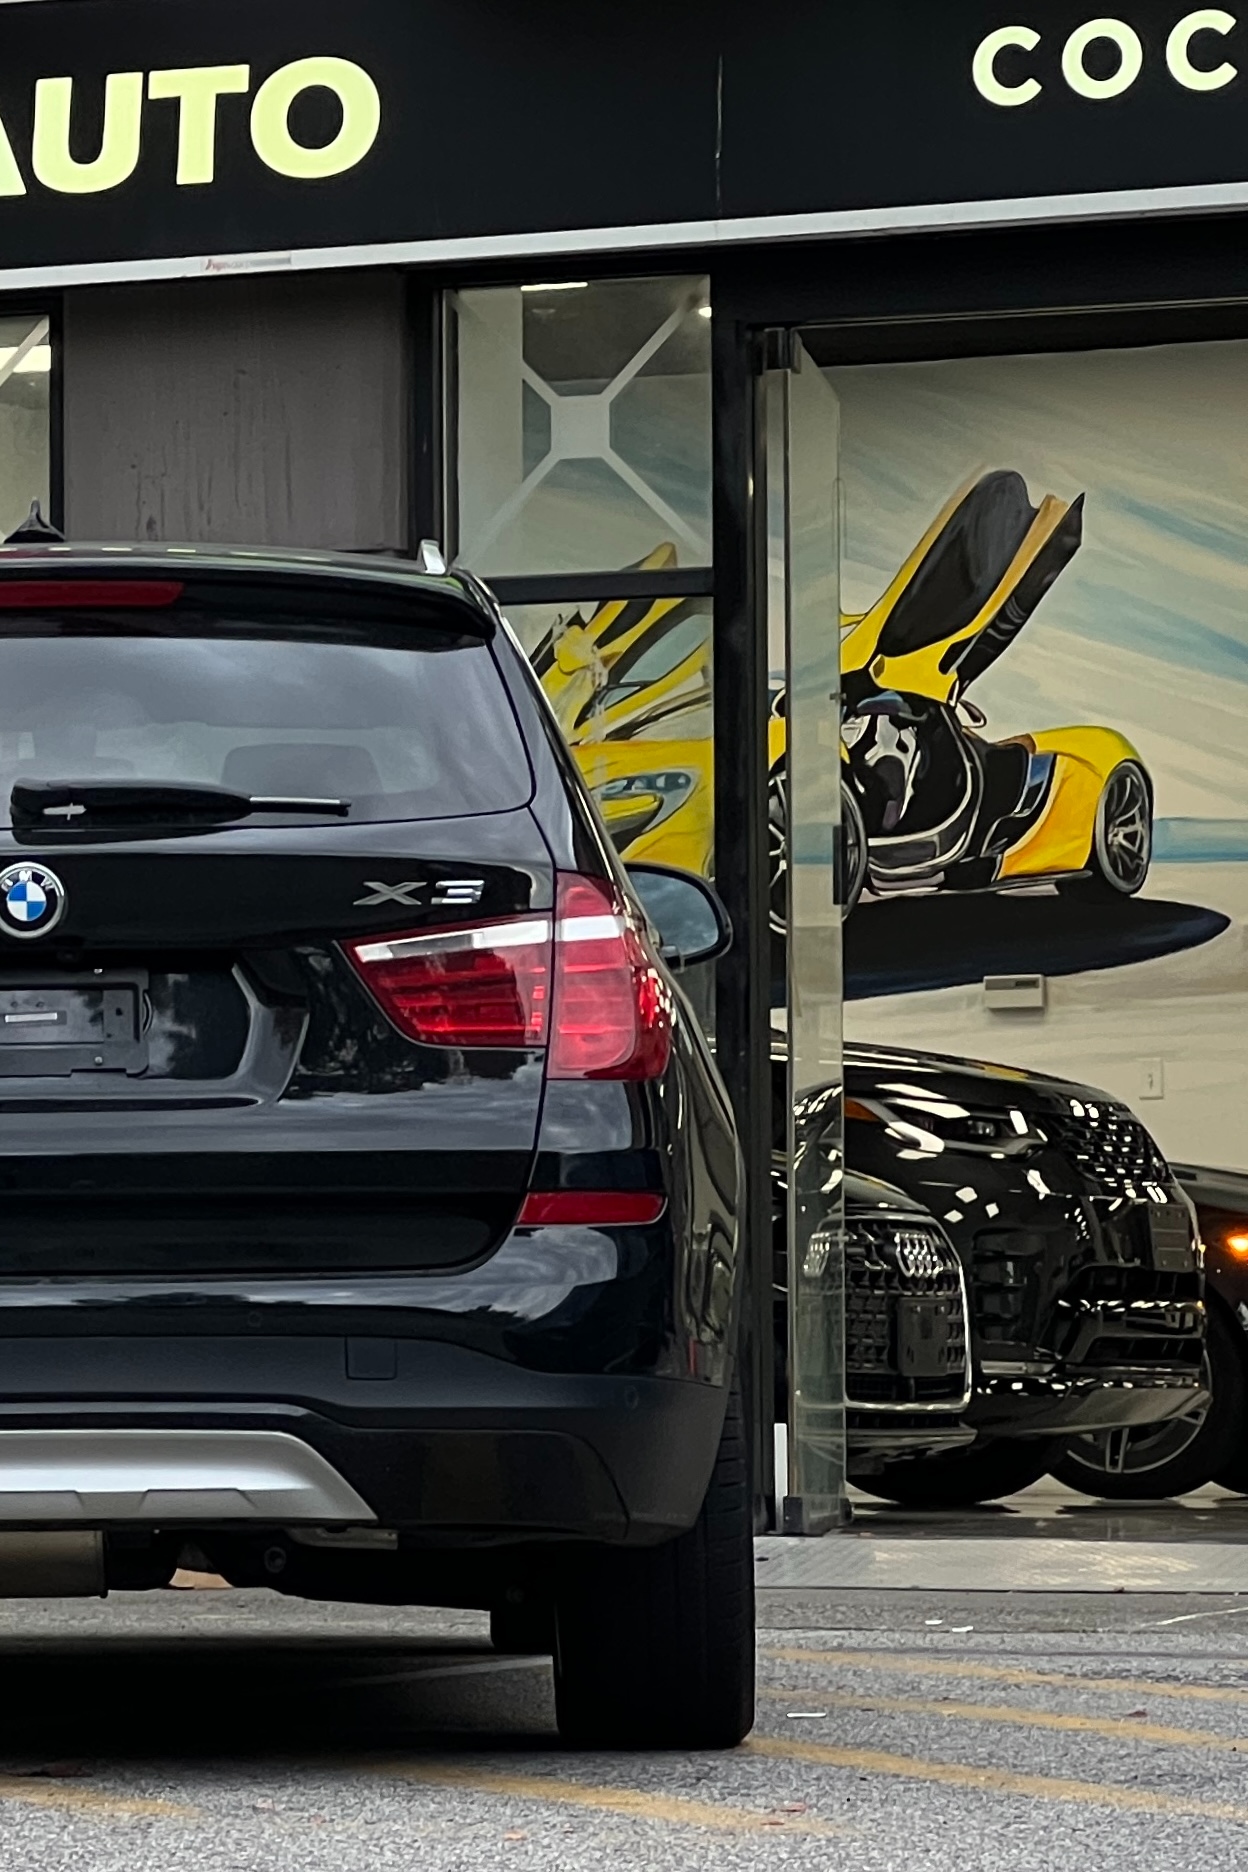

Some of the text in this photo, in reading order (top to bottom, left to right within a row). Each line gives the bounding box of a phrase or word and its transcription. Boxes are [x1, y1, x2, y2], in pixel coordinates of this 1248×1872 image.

[971, 9, 1238, 106] COC
[0, 869, 56, 892] BMW
[352, 879, 485, 905] X3
